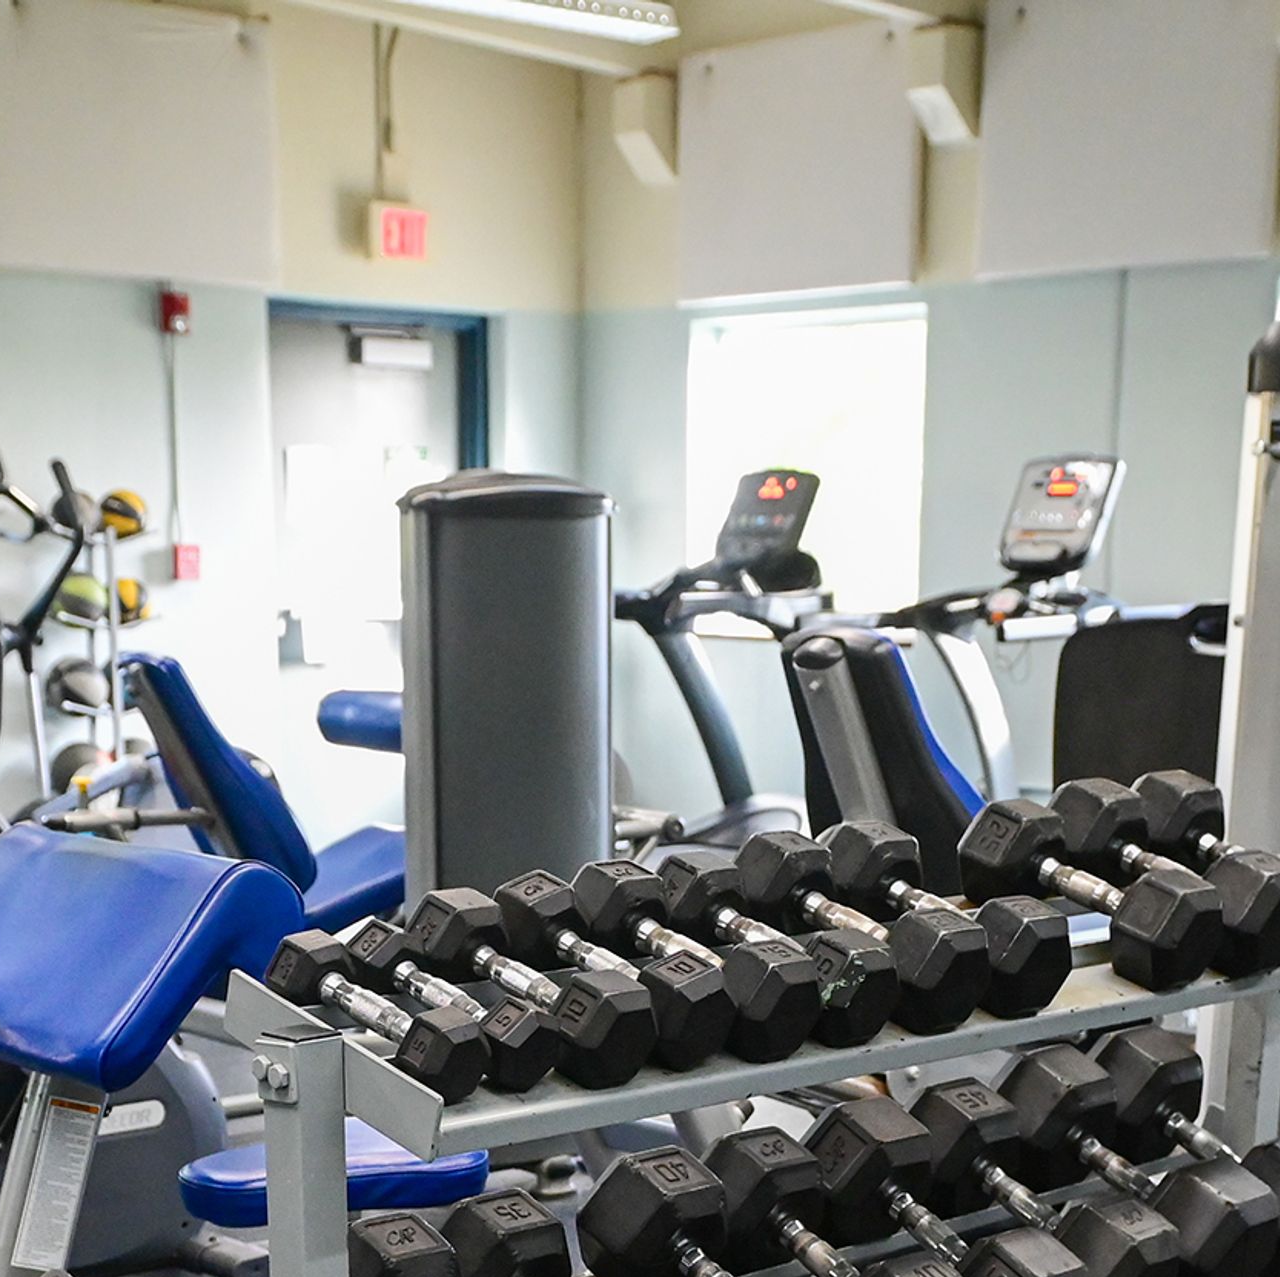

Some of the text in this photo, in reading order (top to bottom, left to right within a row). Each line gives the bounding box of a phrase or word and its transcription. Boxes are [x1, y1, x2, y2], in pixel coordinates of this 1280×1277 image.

[384, 212, 426, 255] EXIT
[667, 960, 697, 975] 10
[495, 1015, 512, 1028] 5
[561, 1000, 588, 1023] 10
[652, 1160, 690, 1183] 40
[386, 1226, 416, 1246] CAP
